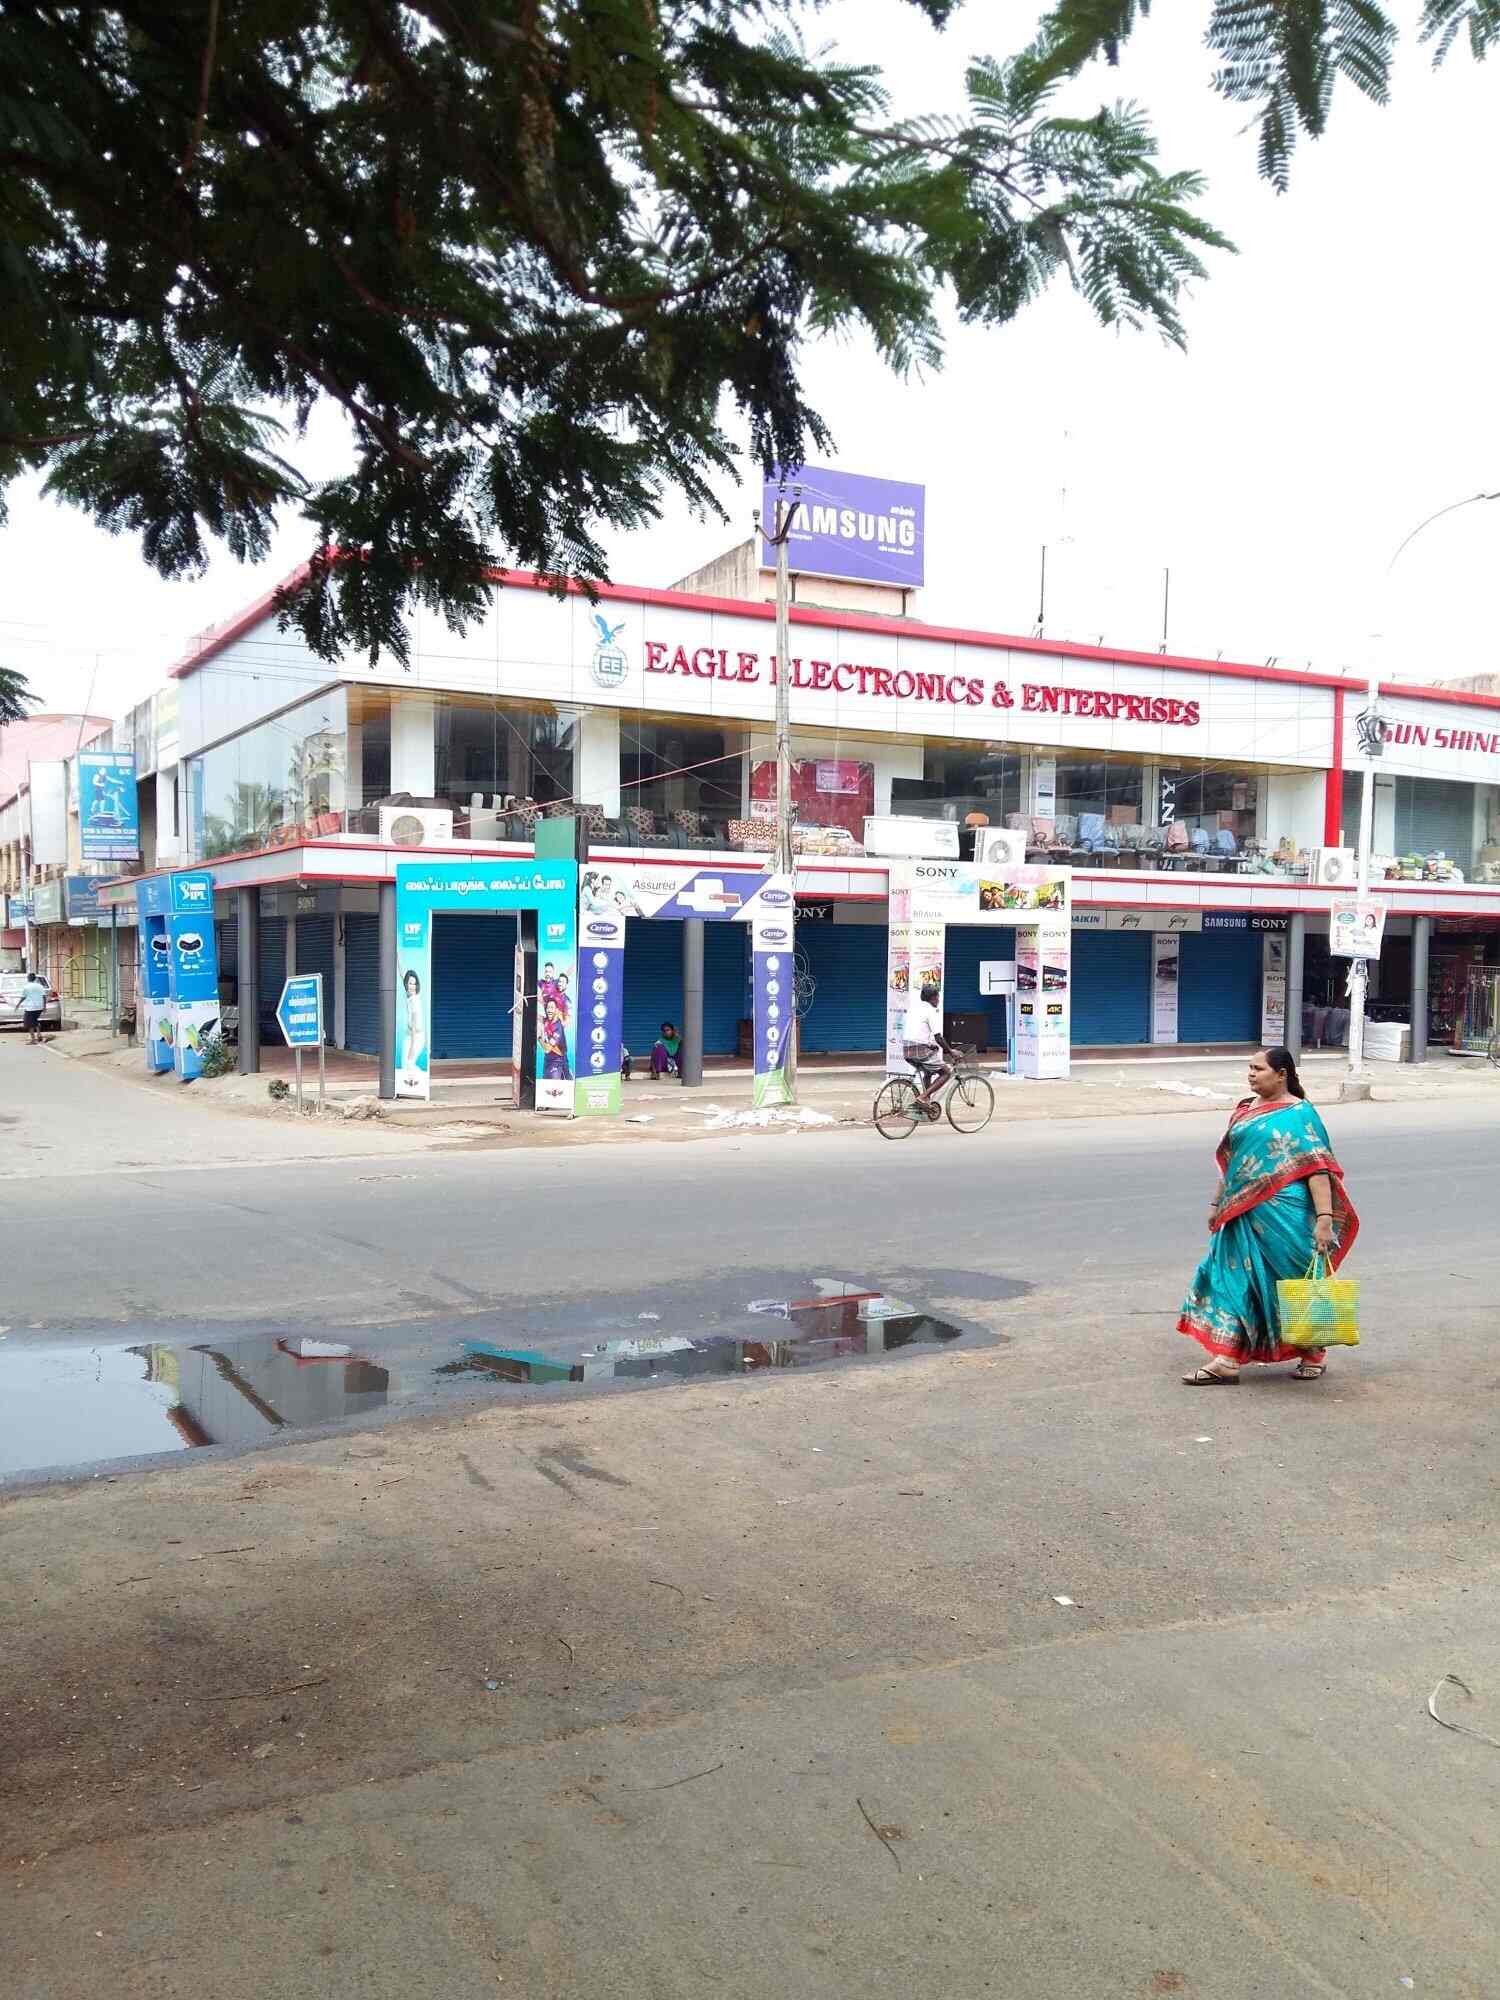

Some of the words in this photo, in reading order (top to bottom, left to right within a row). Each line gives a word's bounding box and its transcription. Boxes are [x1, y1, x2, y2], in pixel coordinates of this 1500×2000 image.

[645, 641, 759, 683] EAGLE
[991, 681, 1013, 708] &
[1020, 683, 1200, 726] ENTERPRISES
[1161, 776, 1175, 824] NY
[915, 866, 959, 878] SONY
[632, 880, 677, 890] Assured
[793, 907, 827, 919] ONY
[1071, 915, 1101, 924] AIKIN
[1204, 917, 1248, 929] SAMSUNG
[1251, 917, 1289, 930] SONY
[890, 929, 909, 937] SONY
[915, 929, 943, 937] SONY
[1017, 930, 1038, 939] SONY
[1042, 930, 1068, 939] SONY
[1156, 938, 1178, 946] SONY
